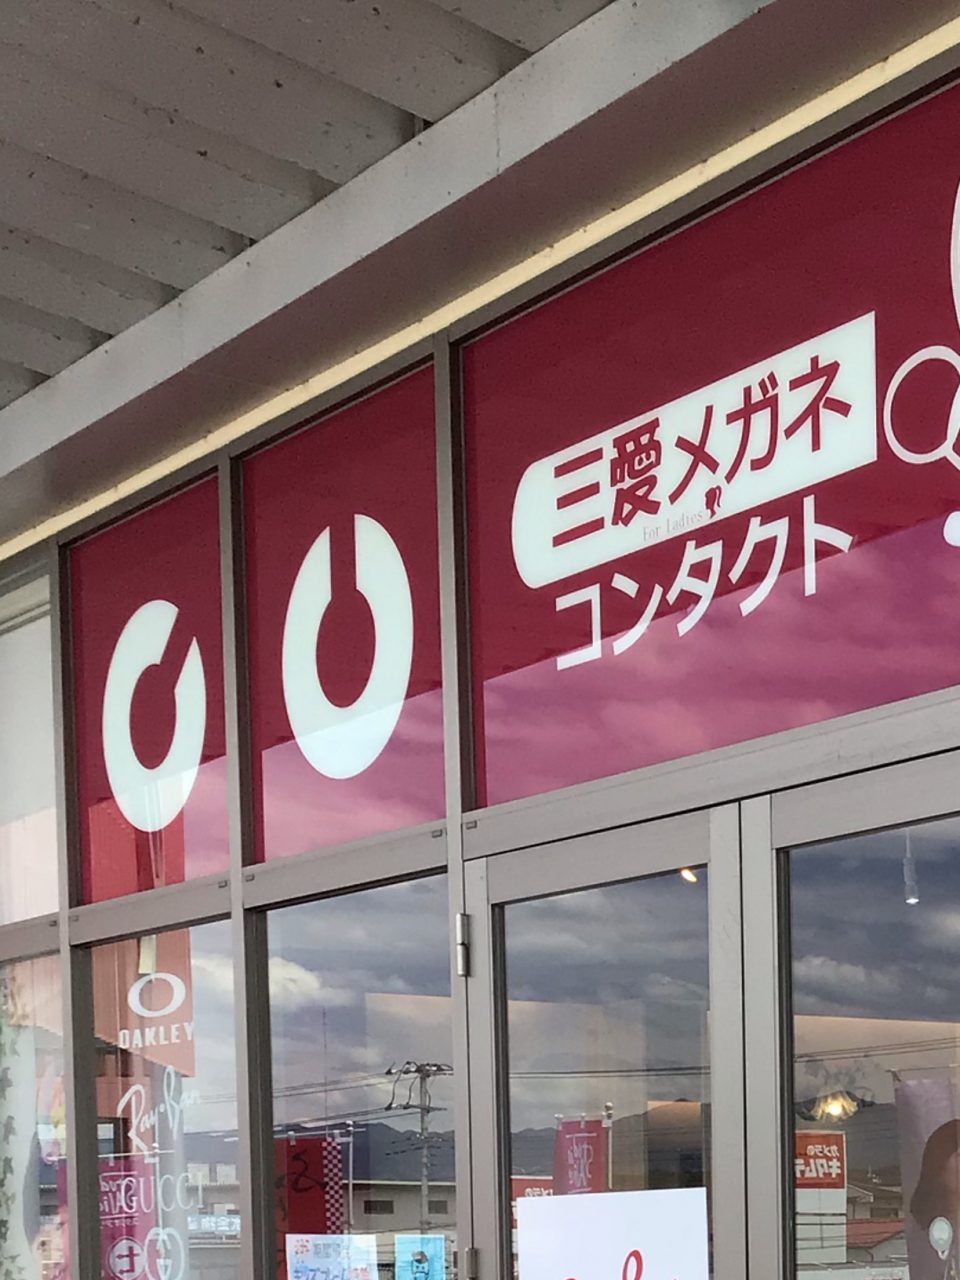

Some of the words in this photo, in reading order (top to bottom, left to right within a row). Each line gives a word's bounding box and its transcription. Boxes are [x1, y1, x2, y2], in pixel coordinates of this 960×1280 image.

[555, 355, 851, 547] 三愛メガネ
[556, 495, 854, 671] コンタクト
[118, 1018, 194, 1050] OAKLEY
